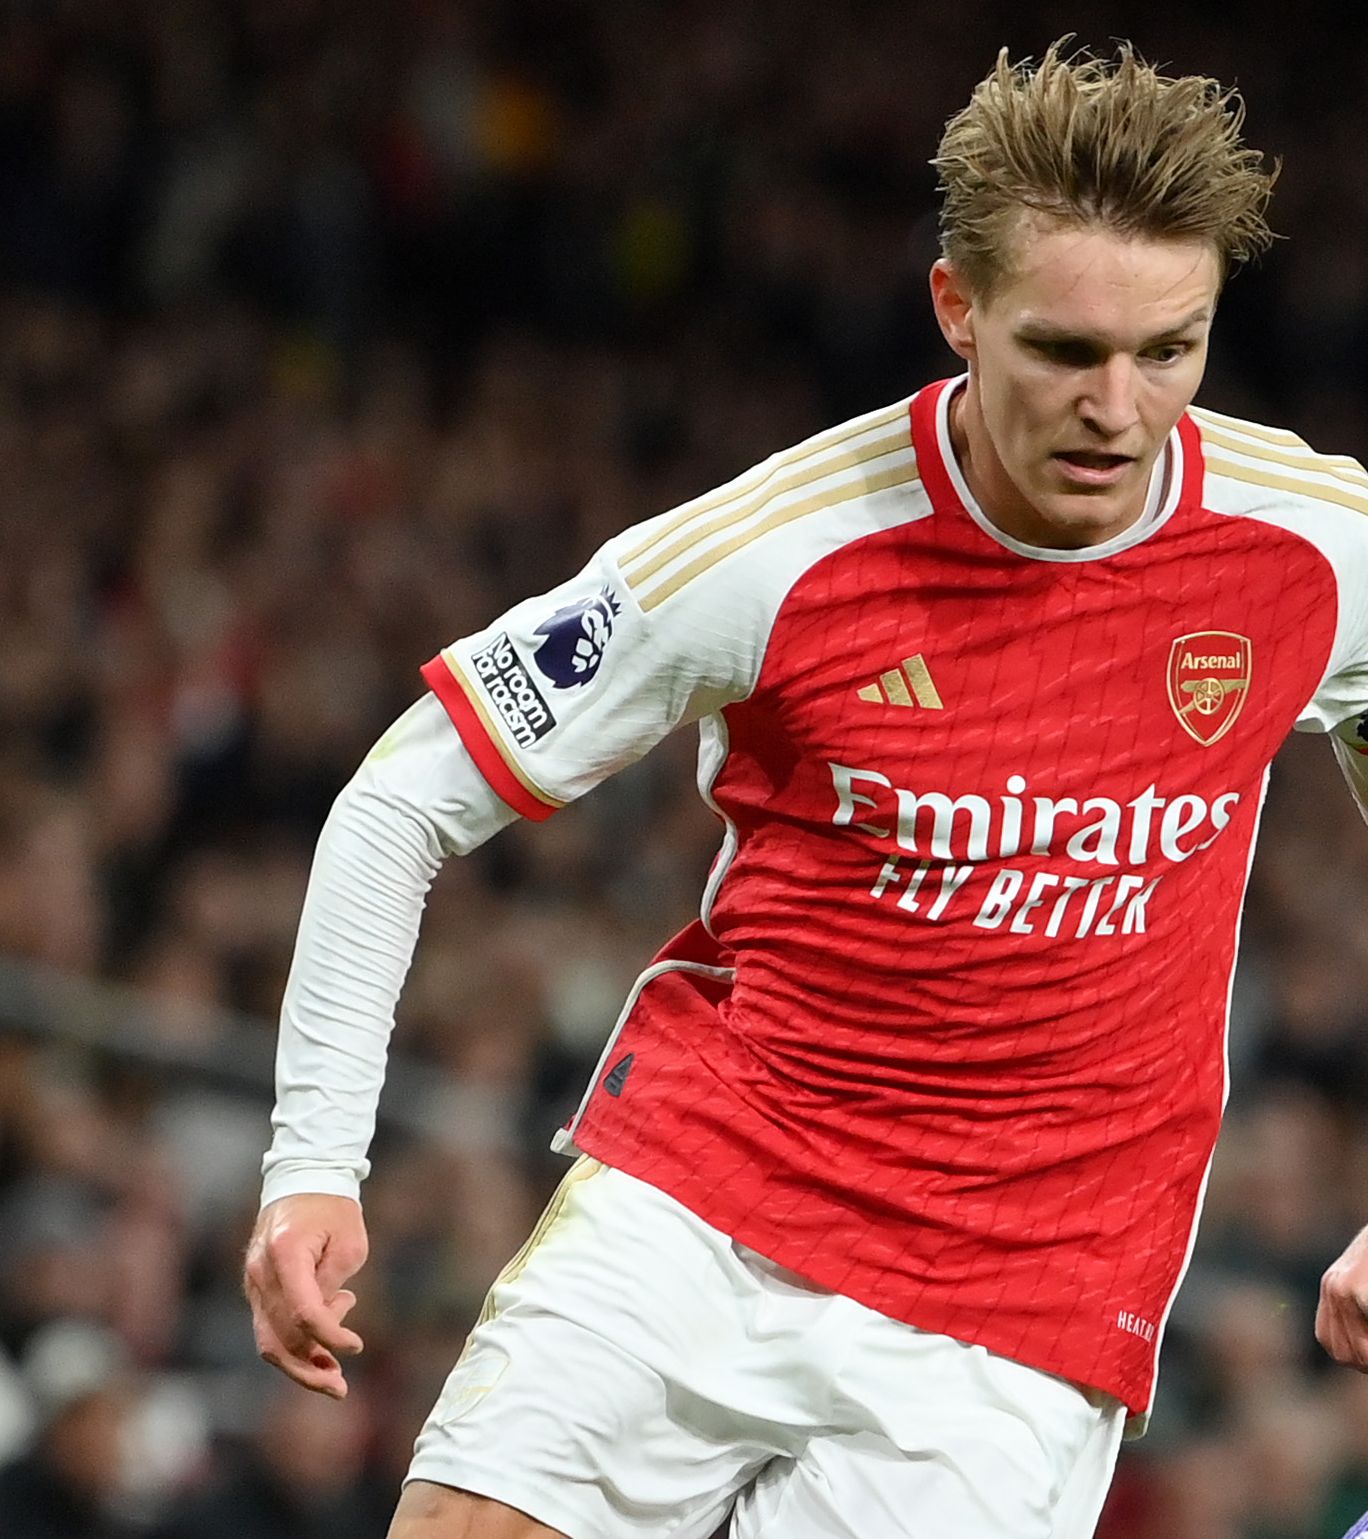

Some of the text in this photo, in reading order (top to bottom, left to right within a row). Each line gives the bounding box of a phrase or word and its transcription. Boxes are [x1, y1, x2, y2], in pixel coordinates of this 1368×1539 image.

[472, 646, 536, 749] for racism
[489, 632, 547, 729] No room
[1181, 652, 1240, 669] Arsenal
[828, 761, 1240, 866] Emirates
[869, 855, 1164, 938] FLY BETTER
